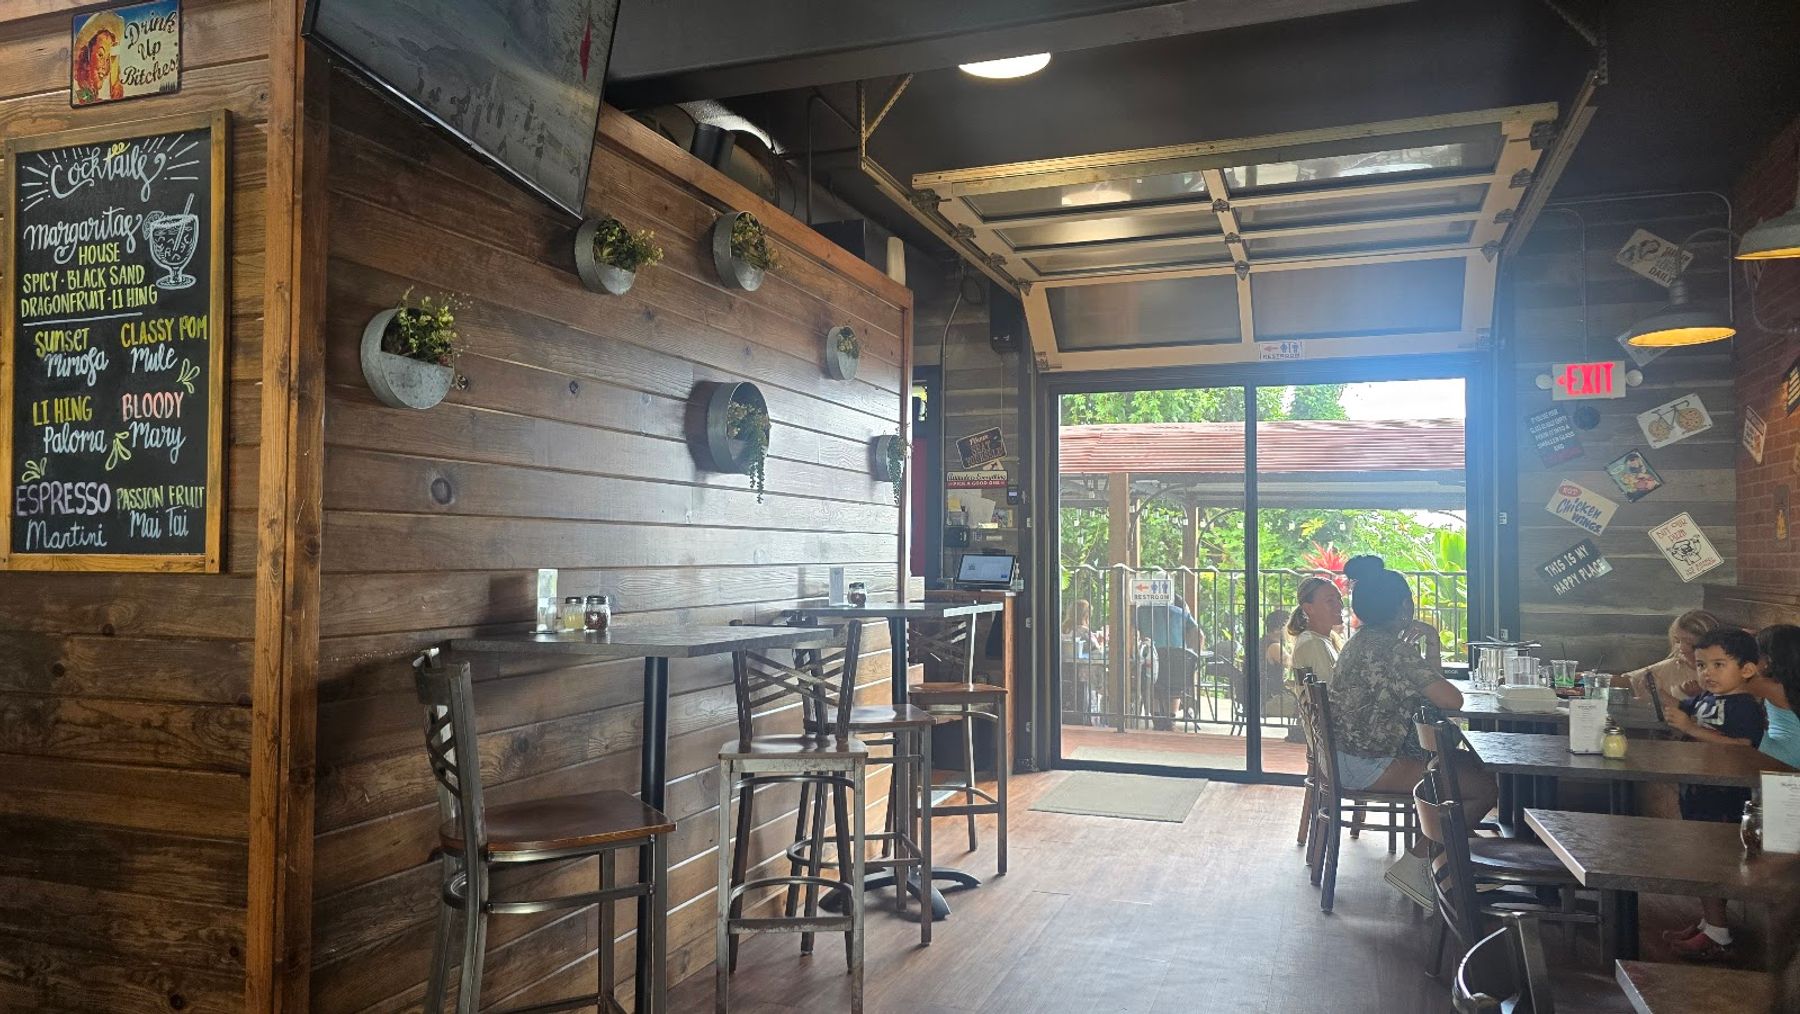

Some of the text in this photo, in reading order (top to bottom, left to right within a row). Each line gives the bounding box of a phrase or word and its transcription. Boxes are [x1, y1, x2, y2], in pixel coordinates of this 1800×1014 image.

[124, 12, 177, 49] Drink
[138, 39, 161, 60] Up
[51, 144, 166, 202] Cocktails
[79, 242, 120, 265] HOUSE
[23, 265, 145, 293] SPICY BLACK SAND
[21, 284, 158, 318] DRAGONFRUIT LI HING
[121, 315, 208, 348] CLASSY POM
[1566, 362, 1615, 395] EXIT
[33, 396, 92, 426] LI HING
[122, 392, 184, 422] BLOODY
[43, 422, 107, 454] Paloma
[16, 481, 112, 516] ESPRESSO
[117, 485, 205, 510] PASSION FRUIT
[26, 519, 107, 550] Martini
[130, 506, 189, 538] Mai Tai
[1544, 545, 1590, 578] THIS IS MY
[1553, 559, 1606, 596] HAPPY PLACE
